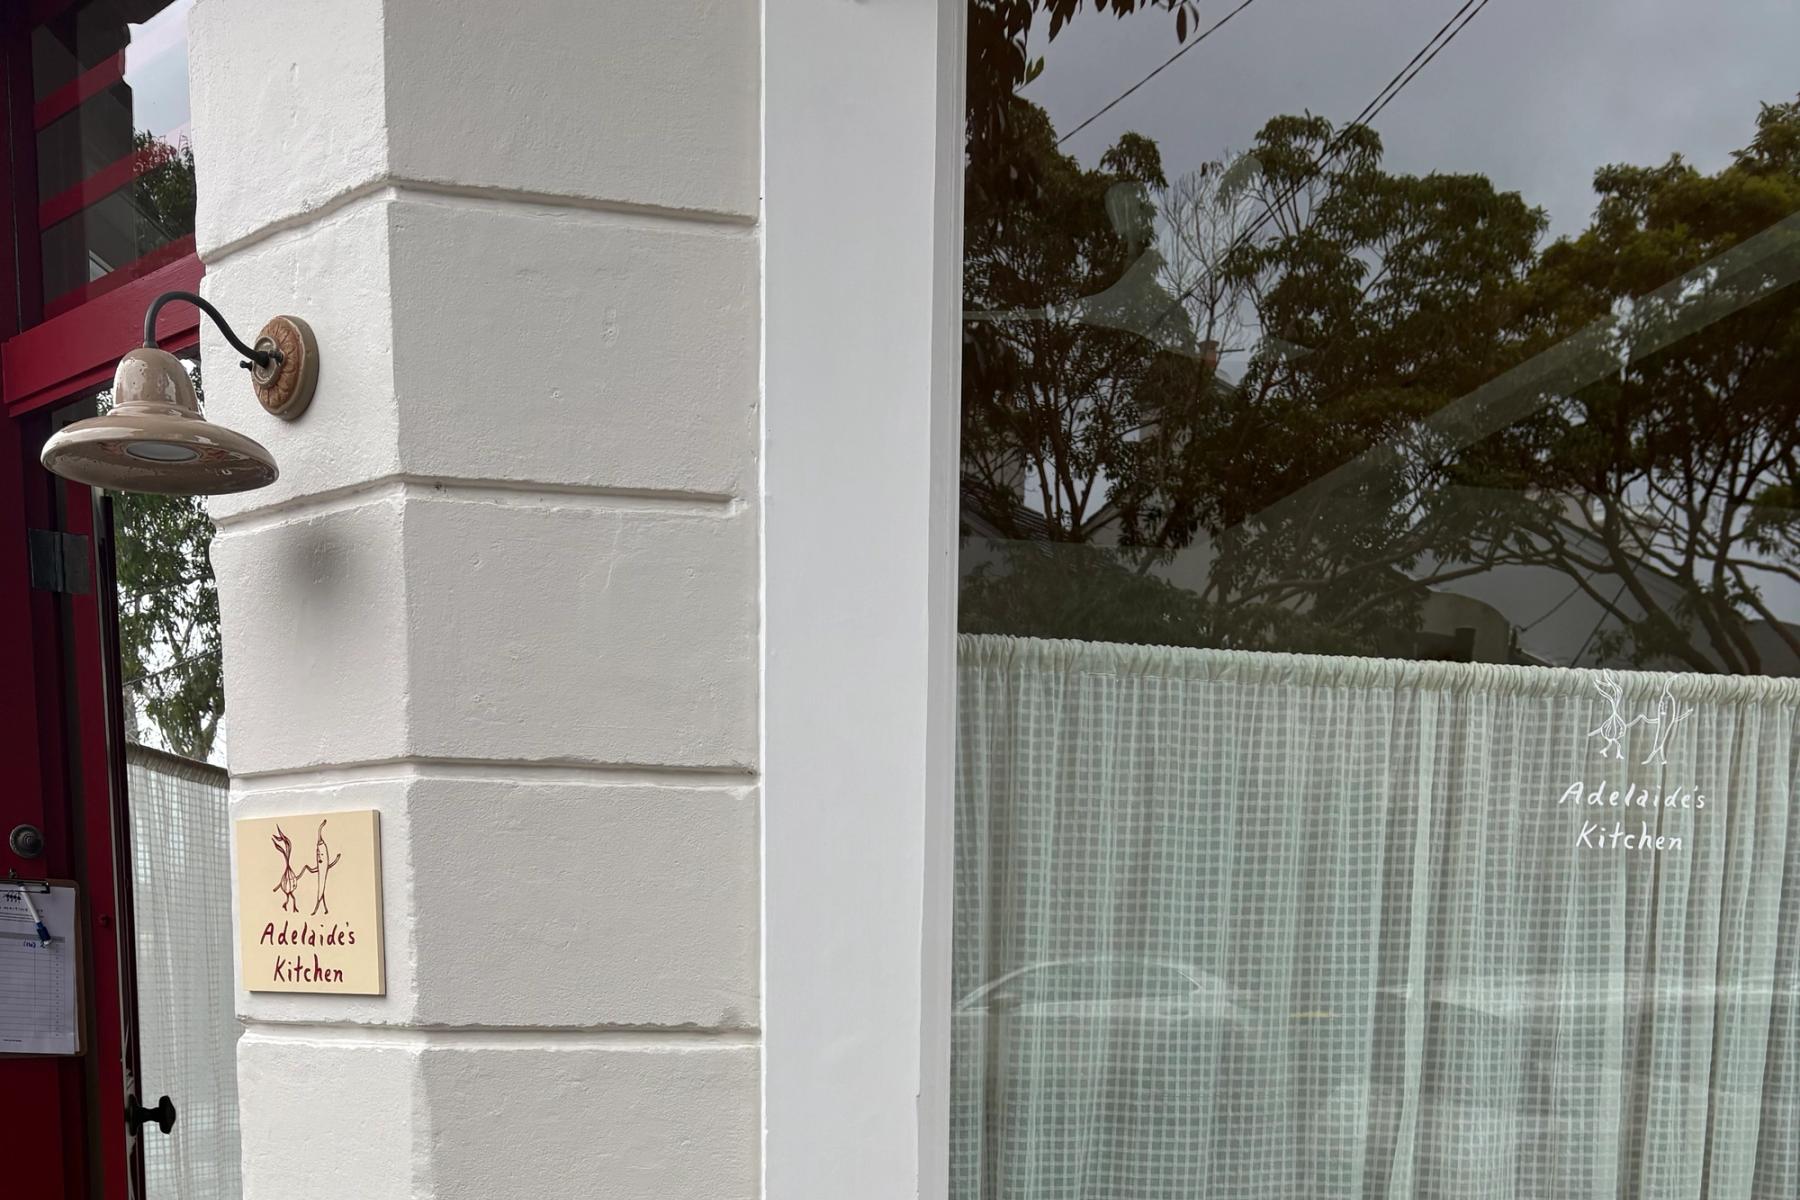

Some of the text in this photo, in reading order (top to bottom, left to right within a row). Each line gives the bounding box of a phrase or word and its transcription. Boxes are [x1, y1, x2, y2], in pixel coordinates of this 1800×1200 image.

[1559, 780, 1706, 809] Adelaide's
[1576, 820, 1682, 850] Kitchen
[260, 920, 356, 946] Adelaide's
[273, 954, 344, 983] Kitchen
